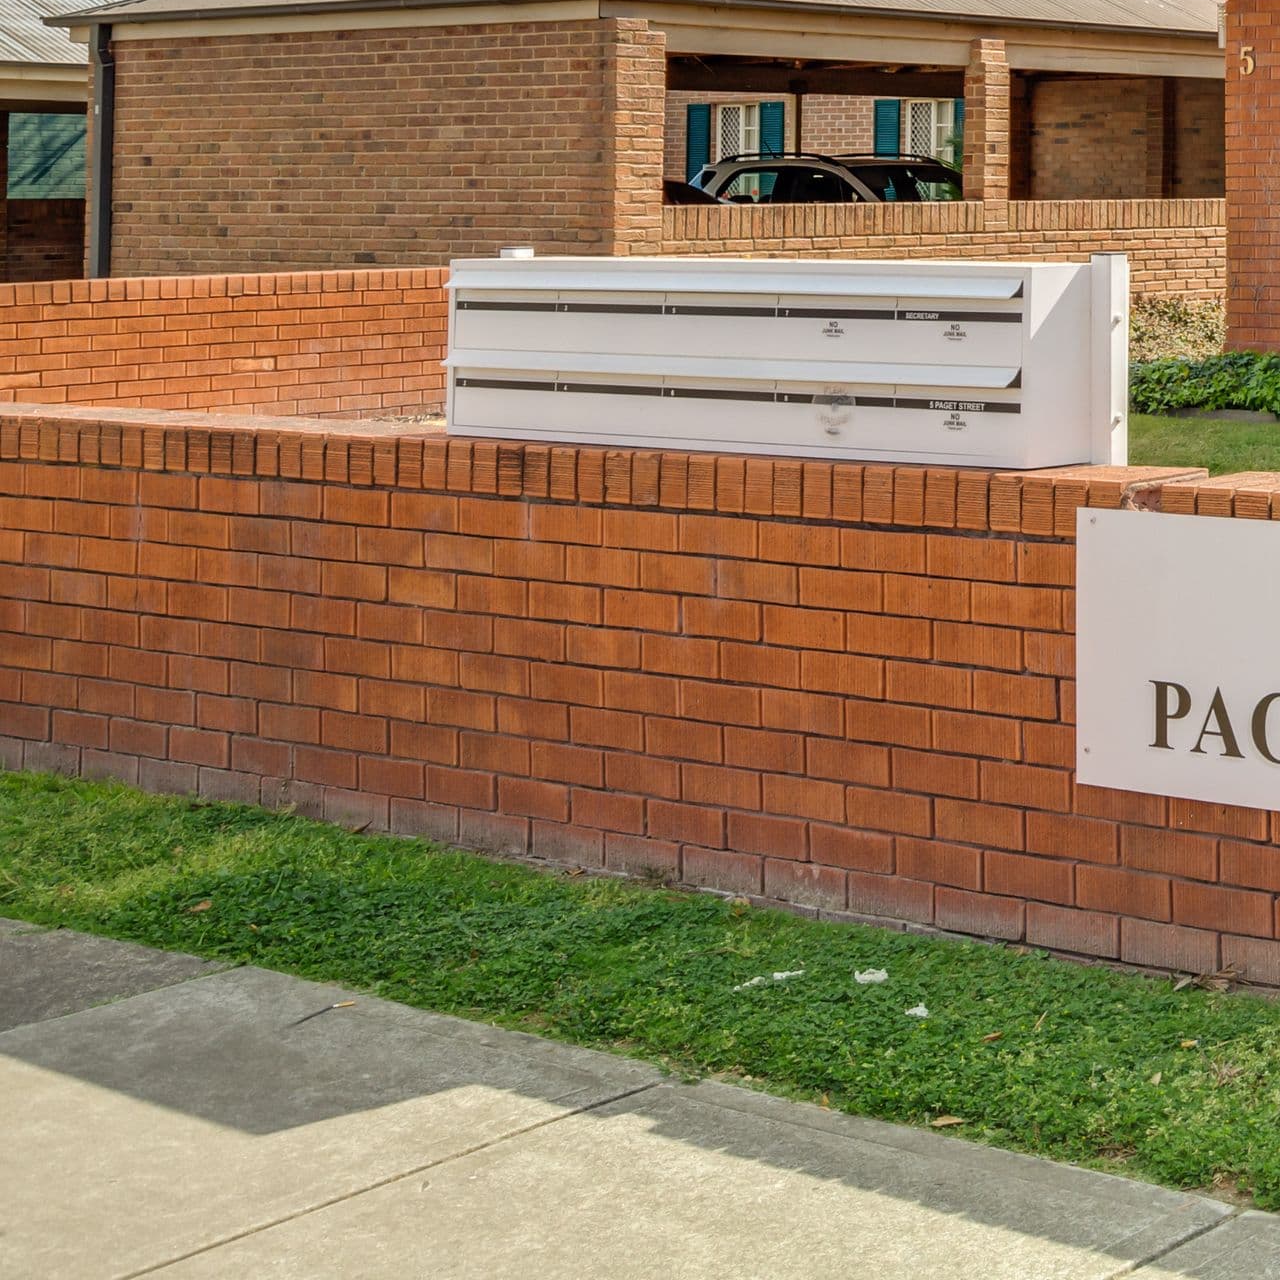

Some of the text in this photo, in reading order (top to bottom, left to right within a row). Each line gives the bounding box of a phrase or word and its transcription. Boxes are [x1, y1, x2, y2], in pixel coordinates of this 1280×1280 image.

[1240, 46, 1255, 76] 5
[905, 312, 940, 320] SECRETARY
[950, 323, 961, 331] NO
[935, 401, 957, 410] PAGET
[958, 402, 985, 411] STREET
[950, 413, 961, 421] NO
